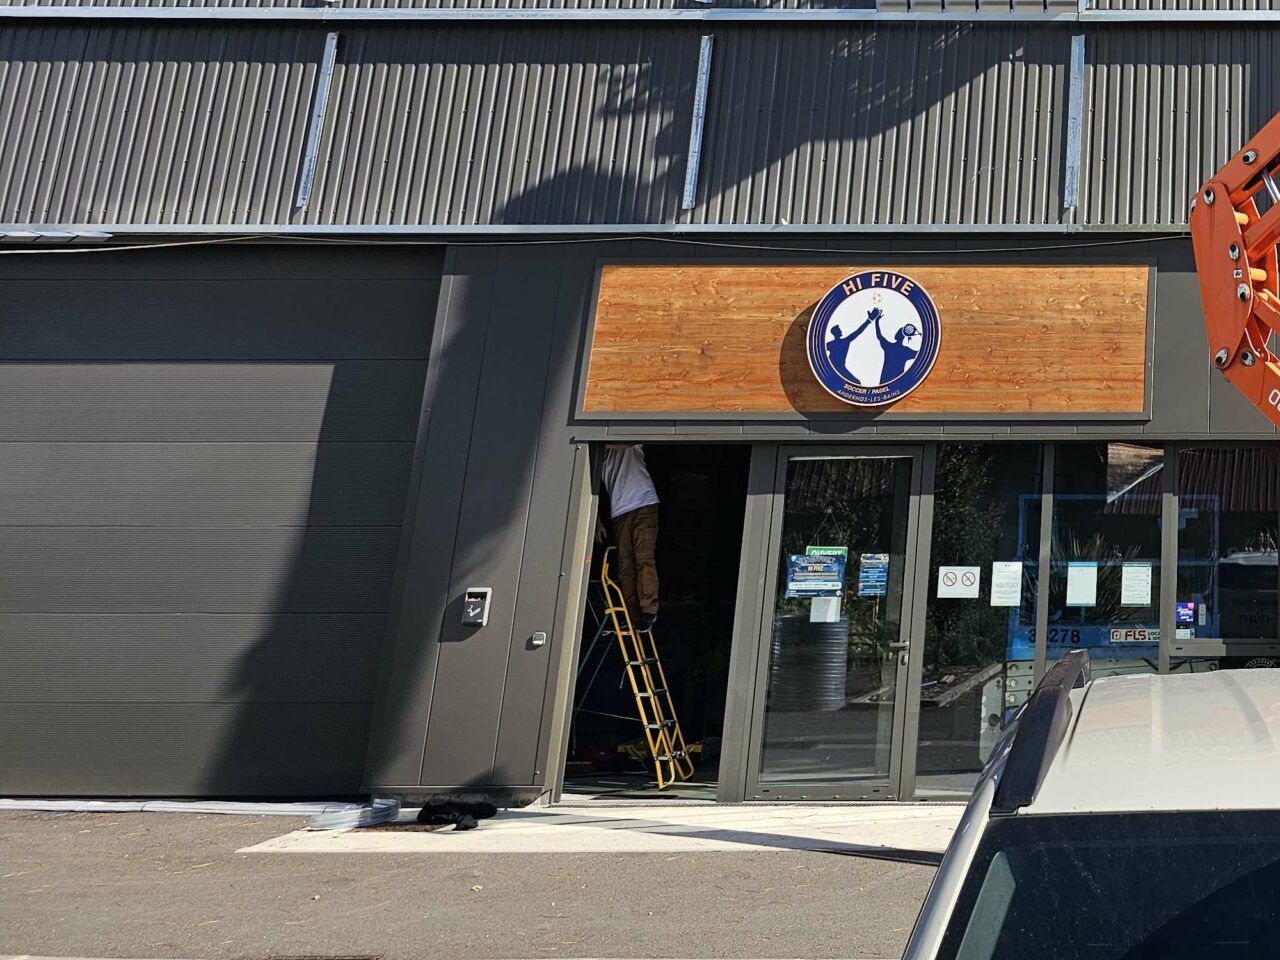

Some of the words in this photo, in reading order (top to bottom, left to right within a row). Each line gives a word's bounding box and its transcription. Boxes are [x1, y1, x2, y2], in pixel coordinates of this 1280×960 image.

[842, 277, 863, 296] HI
[871, 273, 915, 297] FIVE
[843, 383, 866, 395] SOCCER
[871, 385, 890, 395] PADEL
[1125, 630, 1147, 641] FLS
